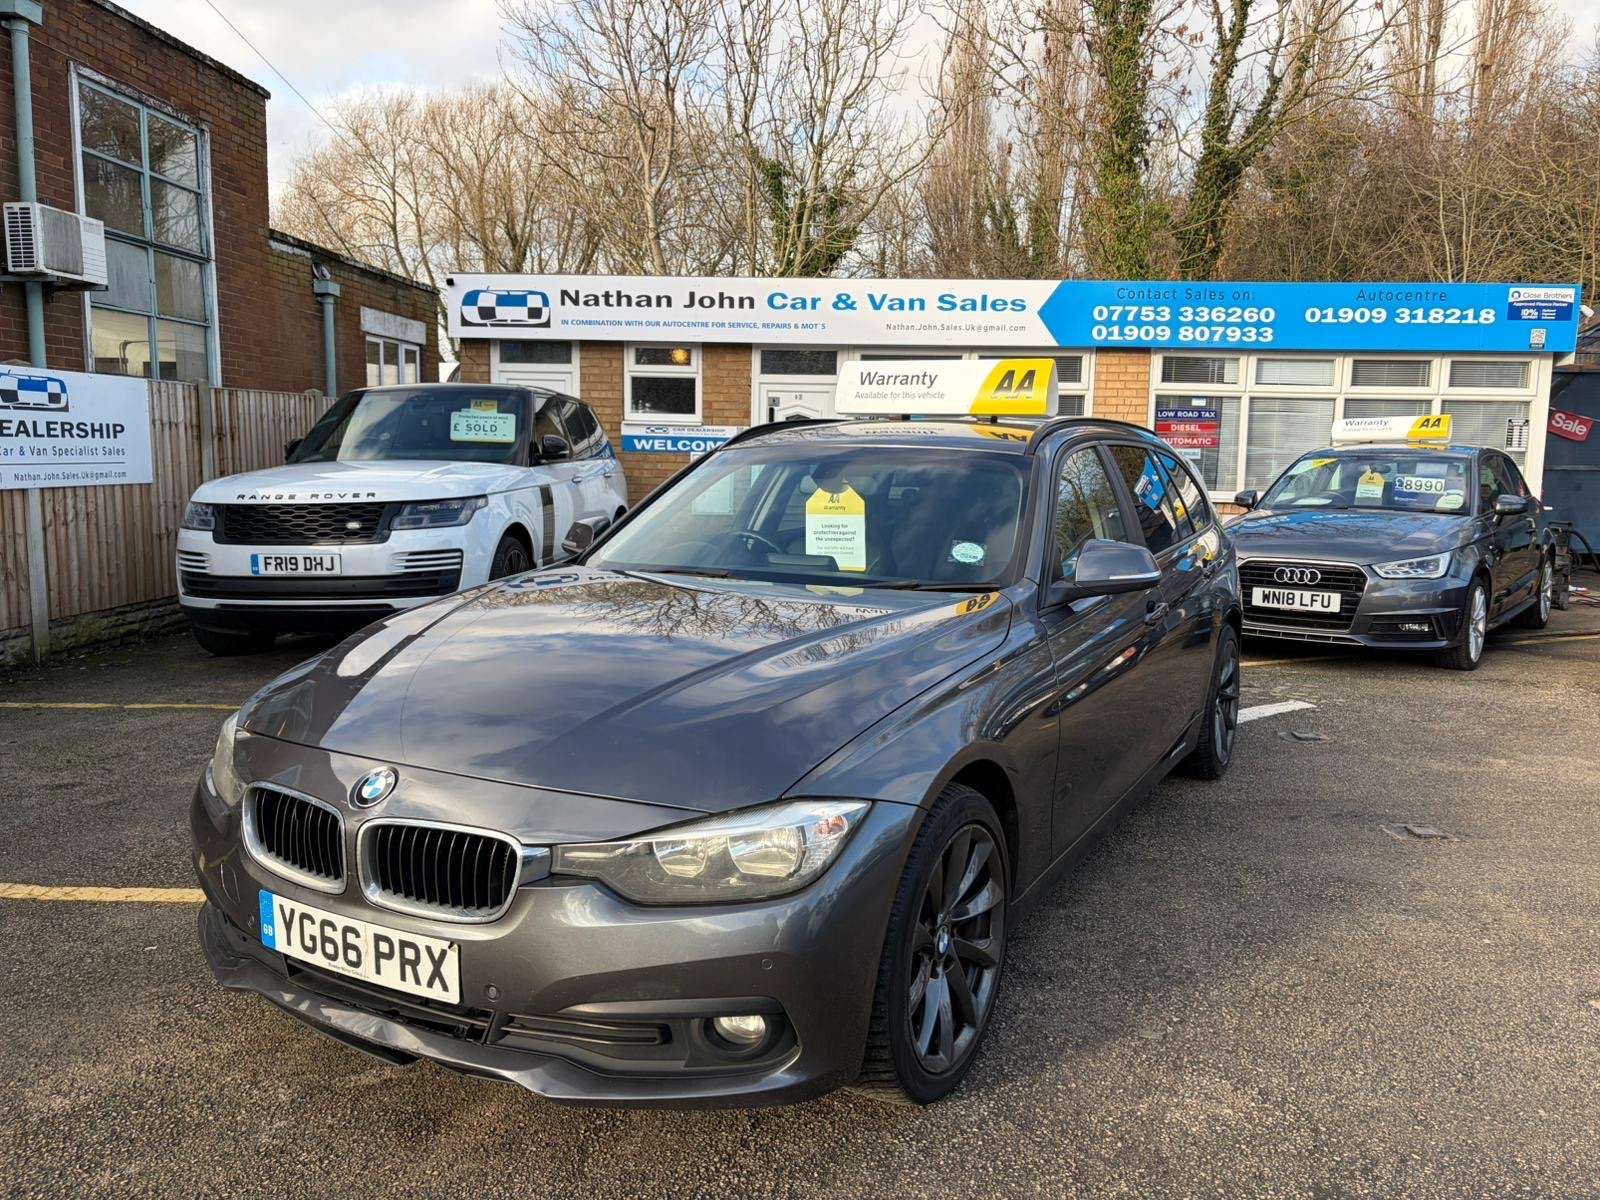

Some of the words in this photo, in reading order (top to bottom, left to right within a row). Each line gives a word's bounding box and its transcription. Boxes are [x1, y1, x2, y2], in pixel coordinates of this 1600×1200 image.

[560, 289, 673, 308] Nathan
[683, 291, 755, 309] John
[767, 292, 822, 311] Car
[832, 293, 858, 311] &
[867, 293, 926, 312] Van
[937, 294, 1027, 312] Sales
[1116, 287, 1178, 300] Contact
[1185, 288, 1225, 301] Sales
[1232, 290, 1256, 301] on:
[1356, 288, 1448, 302] Autocentre
[1093, 305, 1171, 321] 07753
[1178, 306, 1276, 323] 336260
[1305, 307, 1388, 324] 01909
[1394, 308, 1496, 325] 318218
[571, 319, 623, 327] COMBINATION
[645, 320, 661, 328] OUR
[662, 321, 711, 329] AUTOCENTRE
[711, 321, 726, 329] FOR
[727, 322, 760, 330] SERVICE,
[761, 322, 792, 330] REPAIRS
[886, 323, 1026, 333] Nathan.John.Sales.Uk@gmail.com
[1092, 325, 1171, 341] 01909
[1178, 326, 1274, 342] 807933
[860, 371, 939, 388] Warranty
[993, 369, 1036, 394] AA
[855, 391, 888, 399] Available
[890, 390, 902, 400] for
[903, 391, 916, 399] this
[918, 391, 945, 399] vehicle
[453, 423, 460, 432] £
[465, 423, 498, 433] SOLD
[1170, 424, 1201, 432] DIESEL
[1345, 419, 1389, 427] Warranty
[1418, 417, 1442, 429] AA
[1551, 412, 1587, 435] Sale
[19, 446, 26, 456] &
[29, 446, 48, 457] Van
[52, 446, 99, 458] Specialist
[102, 447, 126, 457] Sales
[14, 471, 127, 482] Nathan.John.Sales.Uk@gmail.com
[263, 556, 299, 572] FR19
[302, 556, 335, 572] DHJ
[1262, 590, 1295, 606] WN18
[1300, 592, 1331, 608] LFU
[279, 904, 363, 969] YG66
[373, 932, 450, 993] PRX
